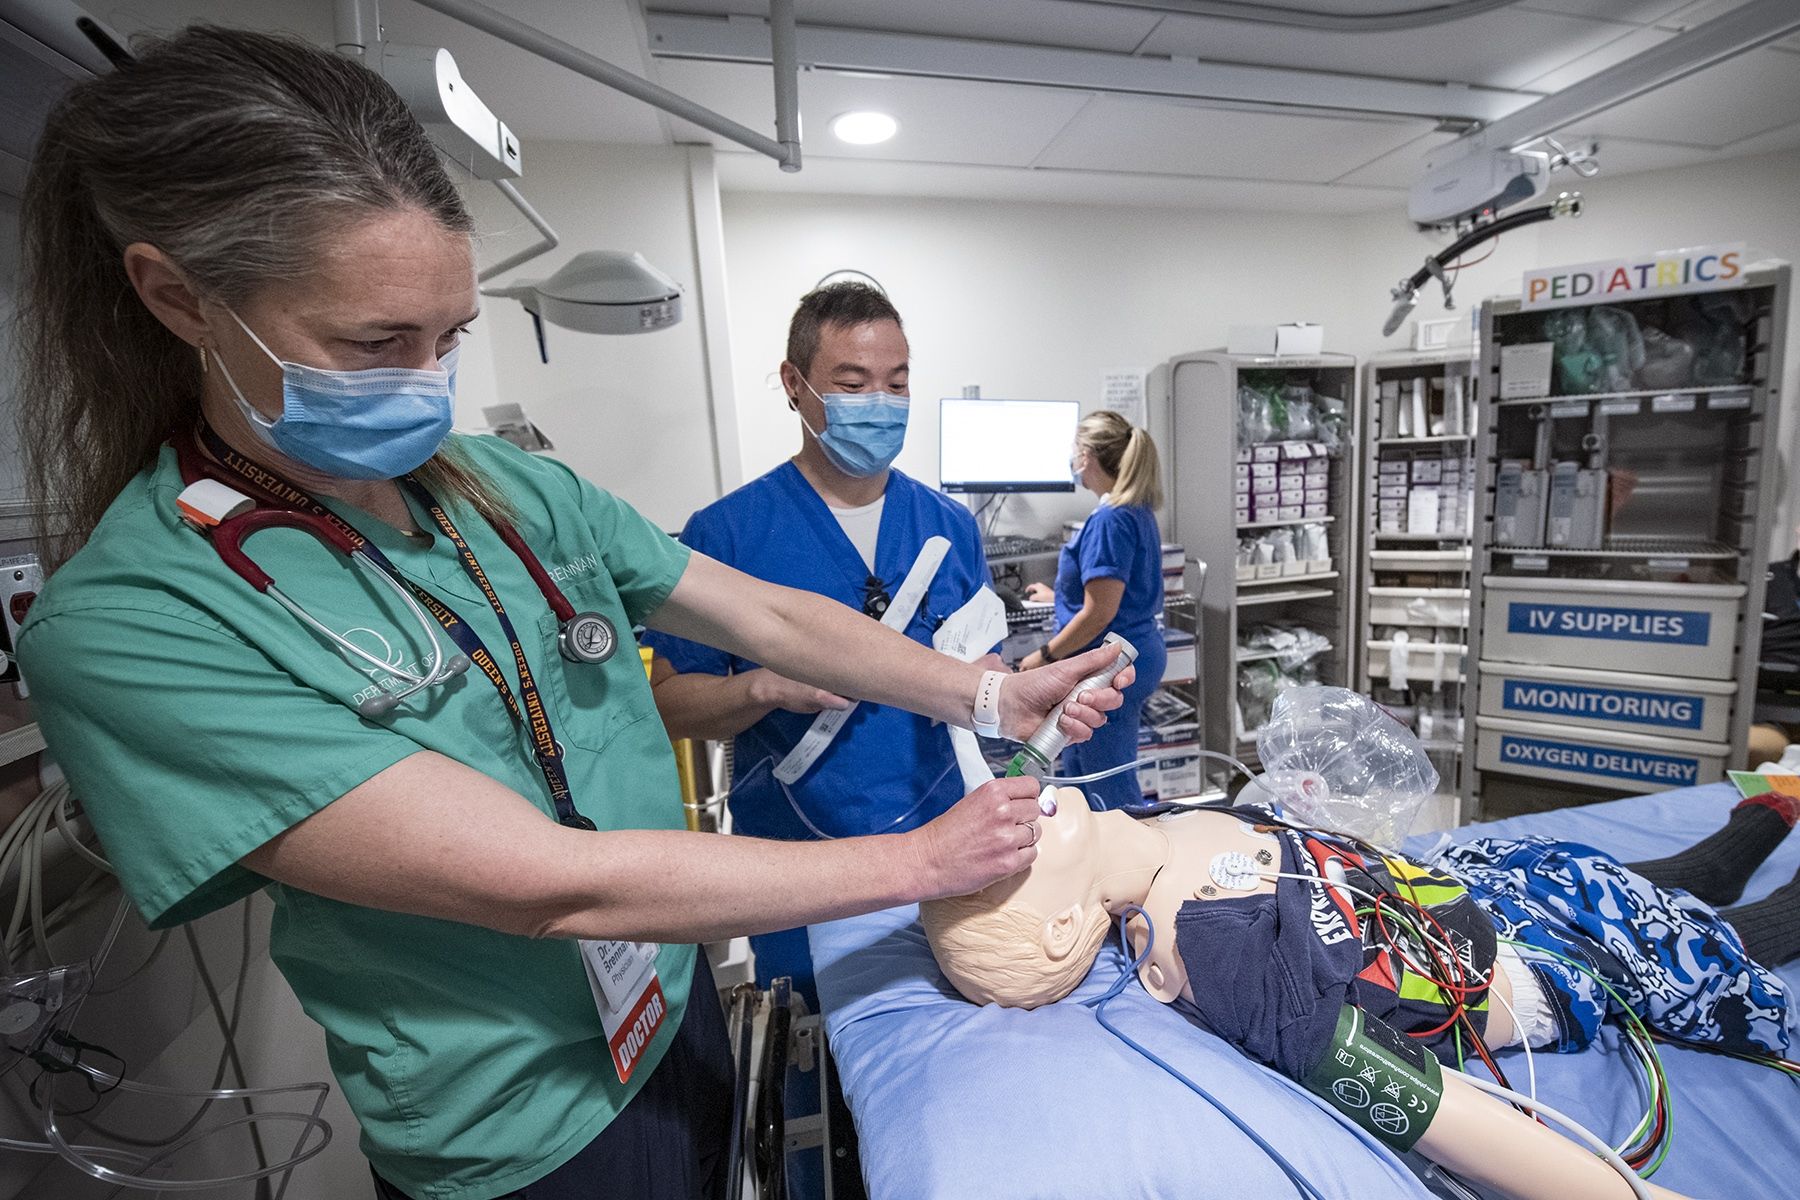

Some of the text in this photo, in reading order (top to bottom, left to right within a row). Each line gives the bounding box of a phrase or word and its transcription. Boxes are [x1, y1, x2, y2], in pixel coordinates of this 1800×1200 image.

[1529, 253, 1740, 302] PEDIATRICS
[223, 451, 309, 508] UNIVERSITY
[431, 506, 505, 615] QUEEN'S UNIVERSITY
[547, 552, 599, 583] RENNAN
[1529, 610, 1684, 637] IV SUPPLIES
[471, 648, 507, 695] QUEEN'S
[511, 641, 533, 689] QUEEN'S
[525, 690, 556, 758] UNIVERSITY
[1514, 687, 1692, 721] MONITORING
[1505, 743, 1697, 781] OXYGEN DELIVERY
[597, 944, 611, 960] Dr.
[611, 955, 634, 986] Physician
[618, 992, 663, 1072] DOCTOR
